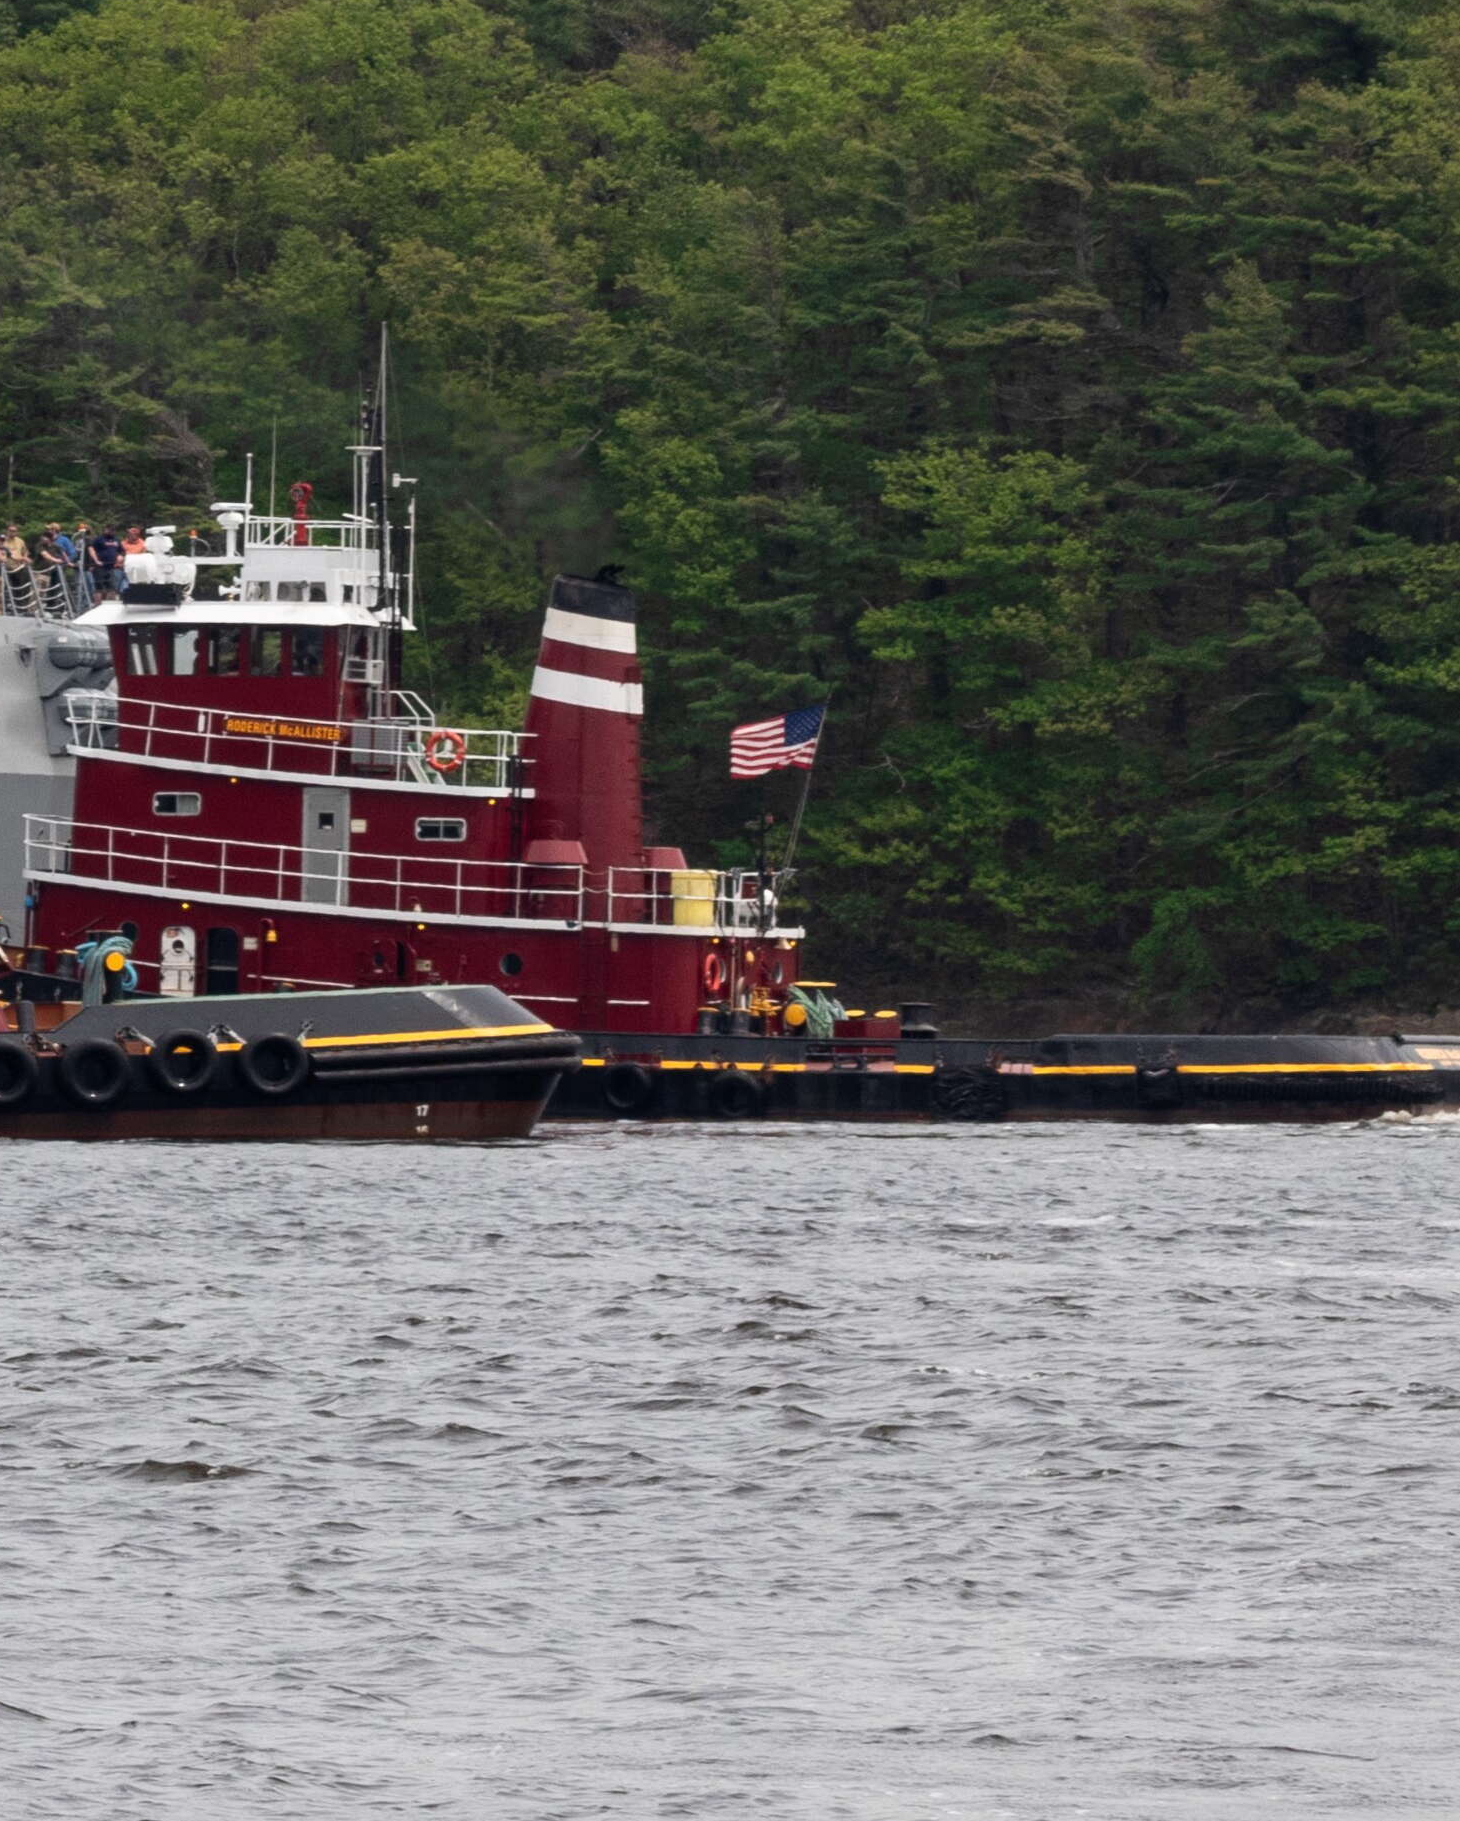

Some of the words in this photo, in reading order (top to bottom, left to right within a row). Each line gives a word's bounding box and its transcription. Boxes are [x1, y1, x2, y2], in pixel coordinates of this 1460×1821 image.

[227, 720, 275, 735] RODERICK
[279, 724, 341, 740] McALLISTER
[416, 1104, 429, 1117] 17
